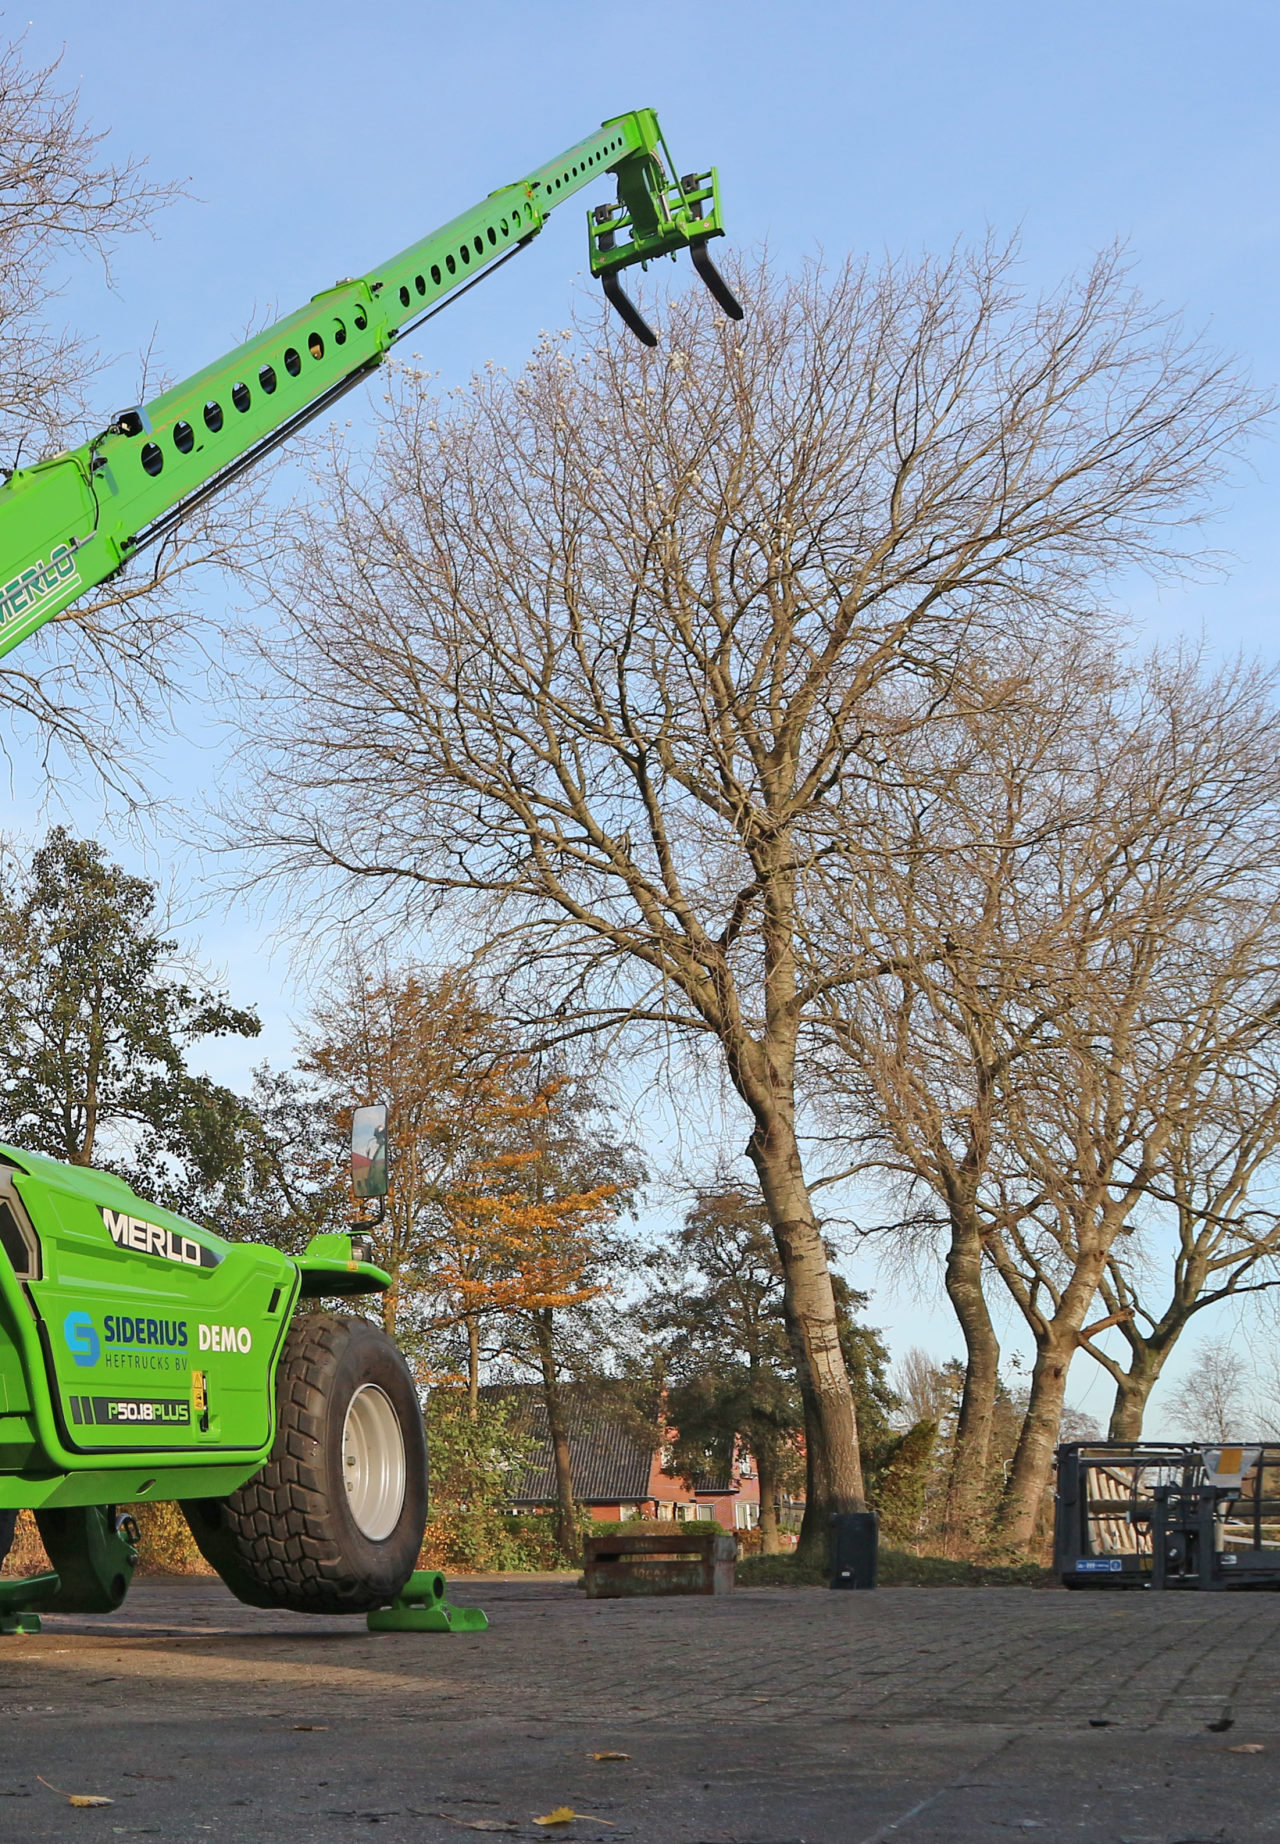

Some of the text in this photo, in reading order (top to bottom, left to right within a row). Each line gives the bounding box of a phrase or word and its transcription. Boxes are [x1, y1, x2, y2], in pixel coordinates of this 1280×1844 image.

[103, 1208, 201, 1266] MERLO
[104, 1315, 188, 1347] SIDERIUS
[198, 1324, 252, 1354] DEMO
[105, 1354, 188, 1371] HEFTRUCKS BV
